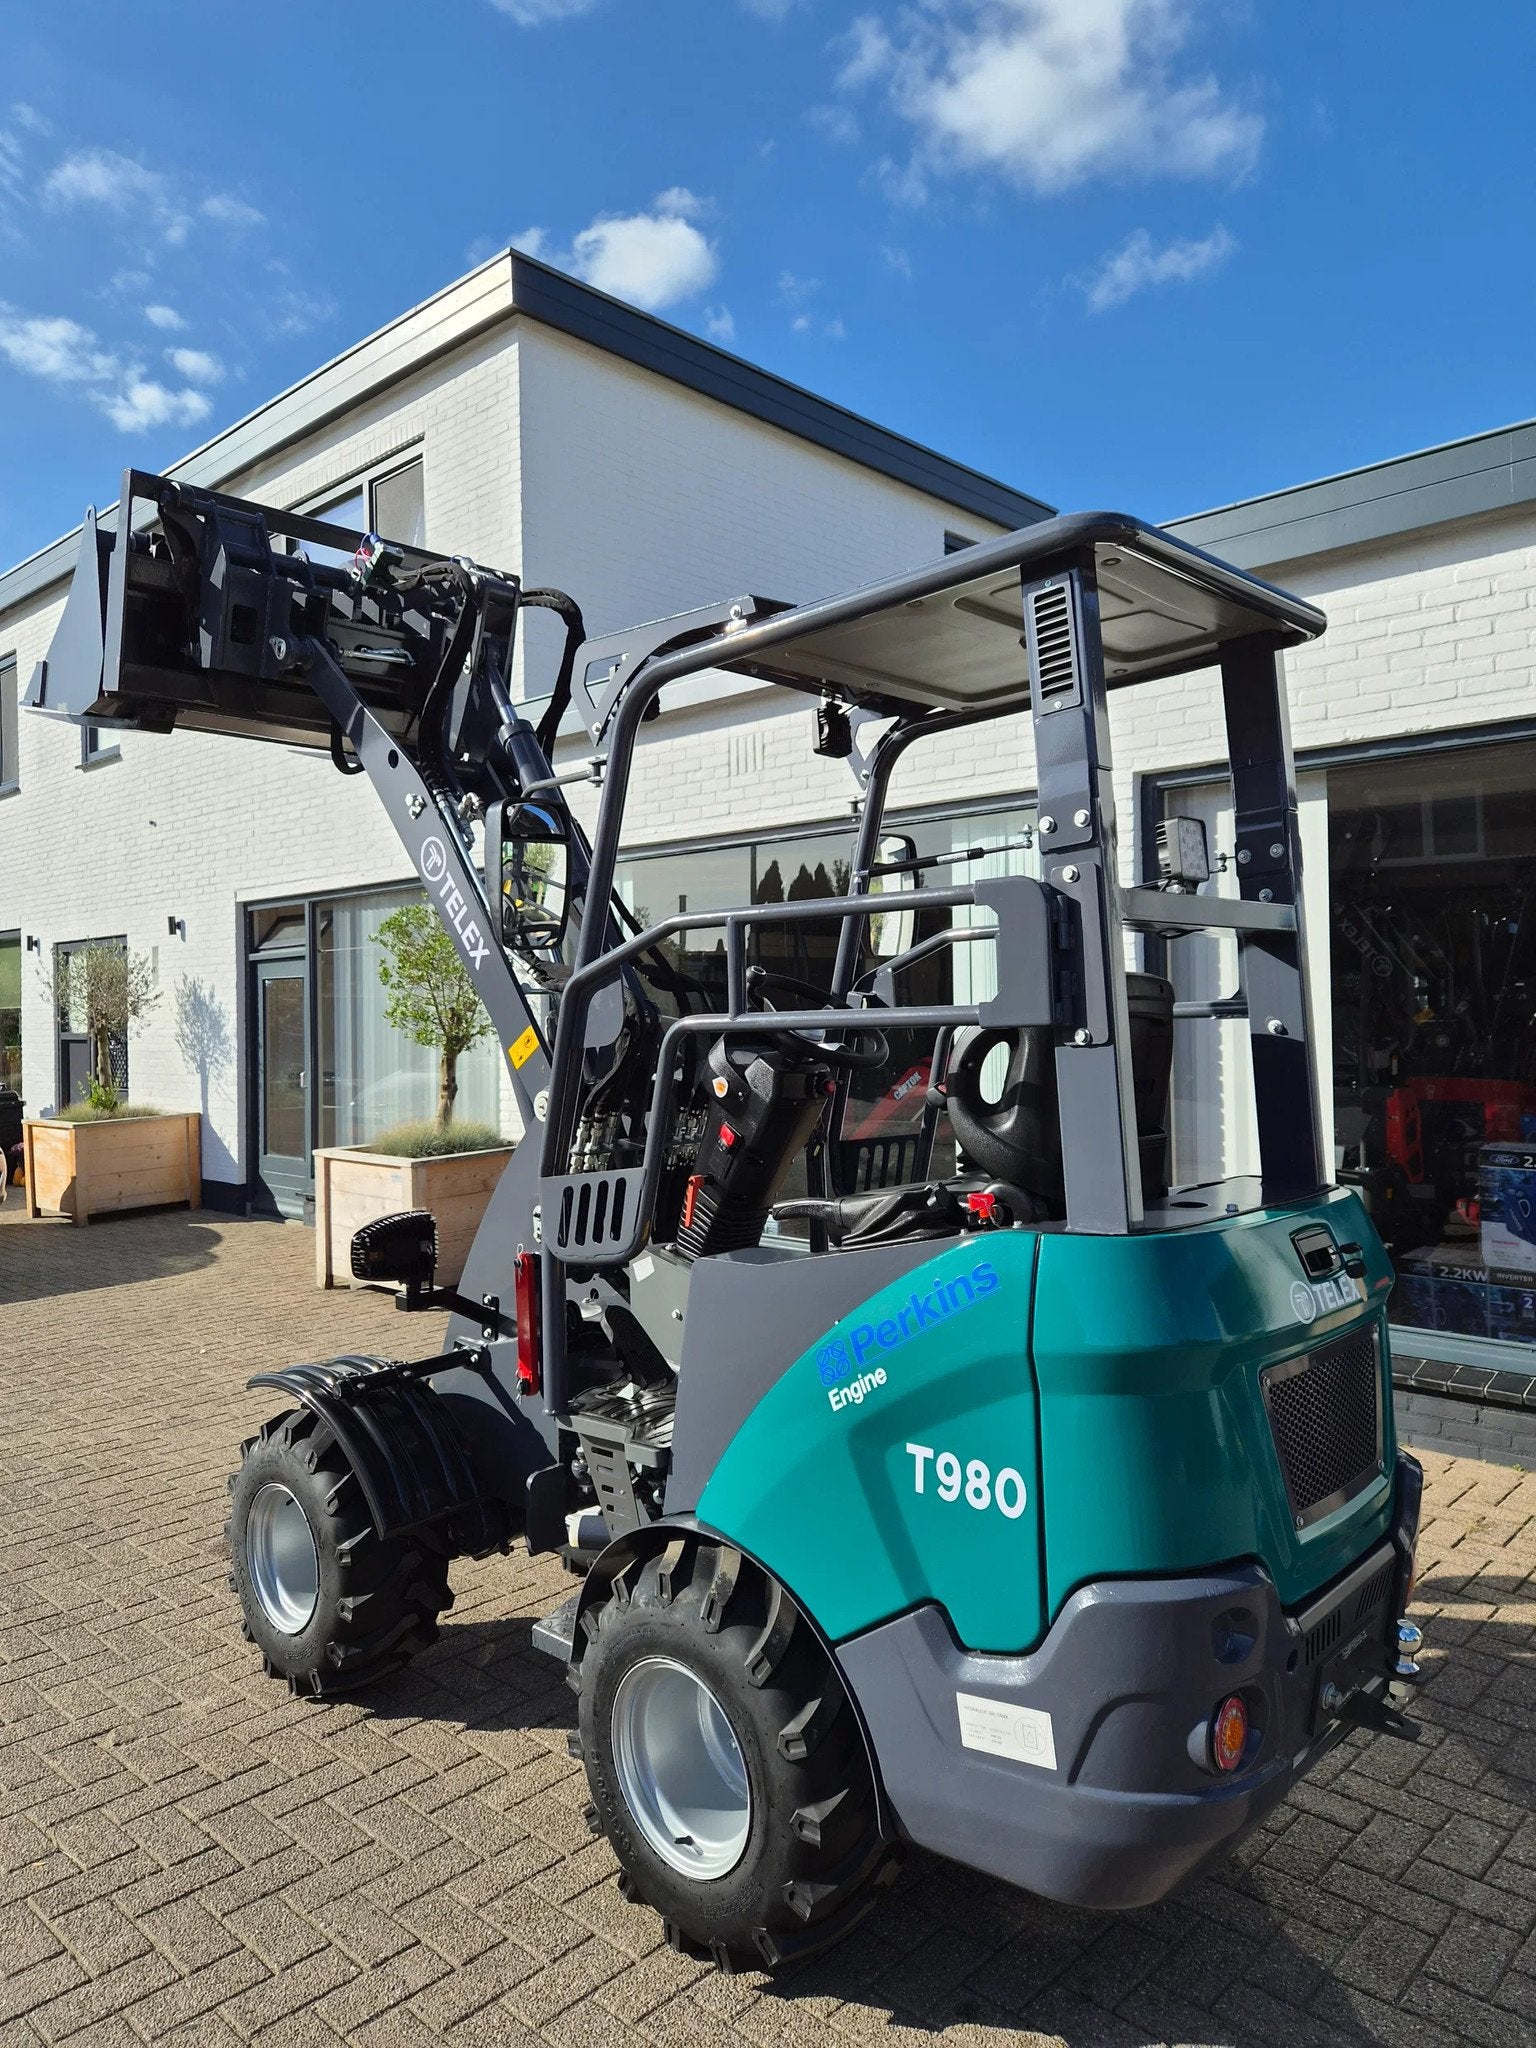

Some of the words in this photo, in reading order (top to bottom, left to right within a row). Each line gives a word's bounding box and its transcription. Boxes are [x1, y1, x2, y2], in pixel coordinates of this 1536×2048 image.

[439, 871, 491, 971] TELEX
[1440, 1265, 1488, 1282] 2.2KW
[1496, 1272, 1534, 1282] INVERTER
[849, 1261, 999, 1366] Perkins
[828, 1367, 888, 1412] Engine
[906, 1442, 1027, 1519] T980
